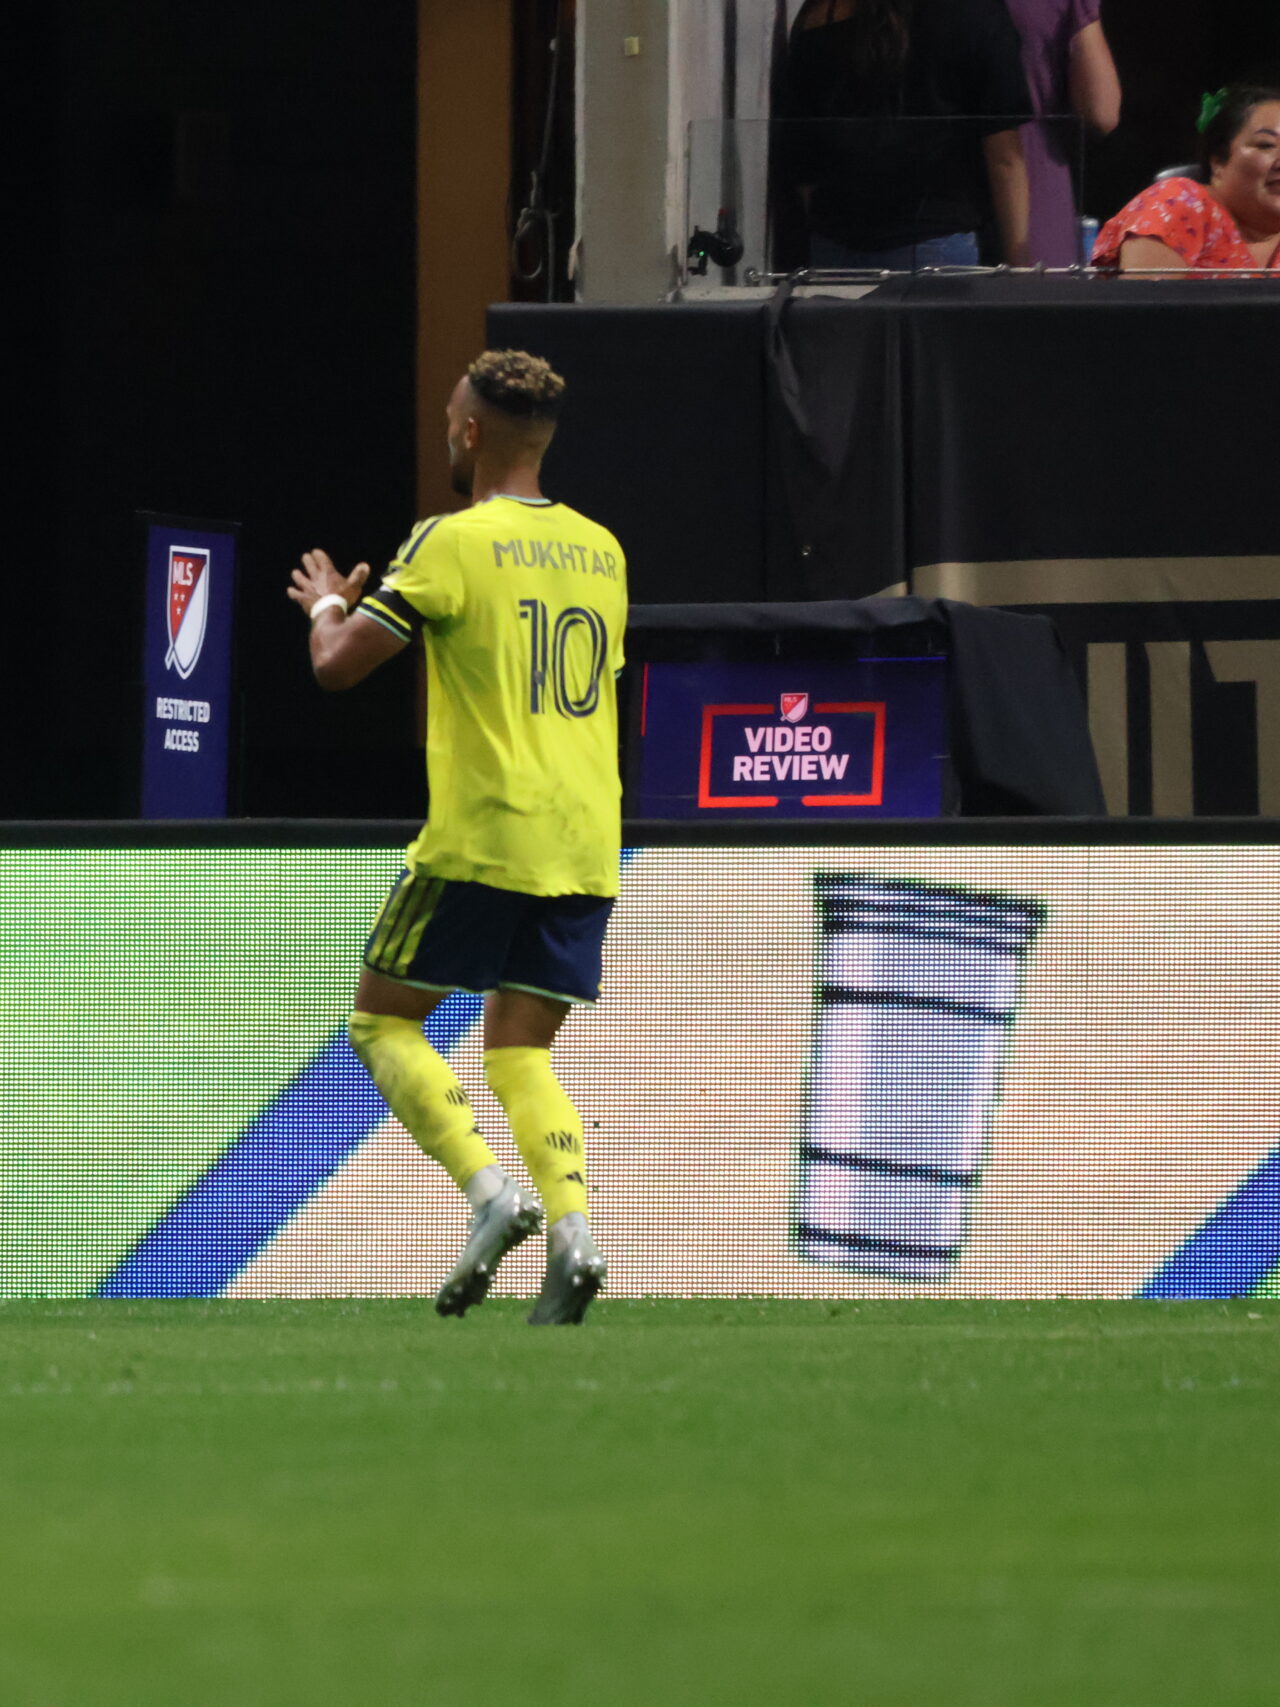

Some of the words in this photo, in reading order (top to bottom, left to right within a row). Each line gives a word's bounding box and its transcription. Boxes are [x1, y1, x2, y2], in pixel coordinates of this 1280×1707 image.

[172, 561, 193, 586] MLS
[492, 539, 617, 582] MUKHTAR
[518, 598, 608, 721] 10
[156, 696, 210, 723] RESTRICTED
[163, 728, 199, 752] ACCESS
[744, 726, 832, 753] VIDEO
[733, 754, 850, 781] REVIEW
